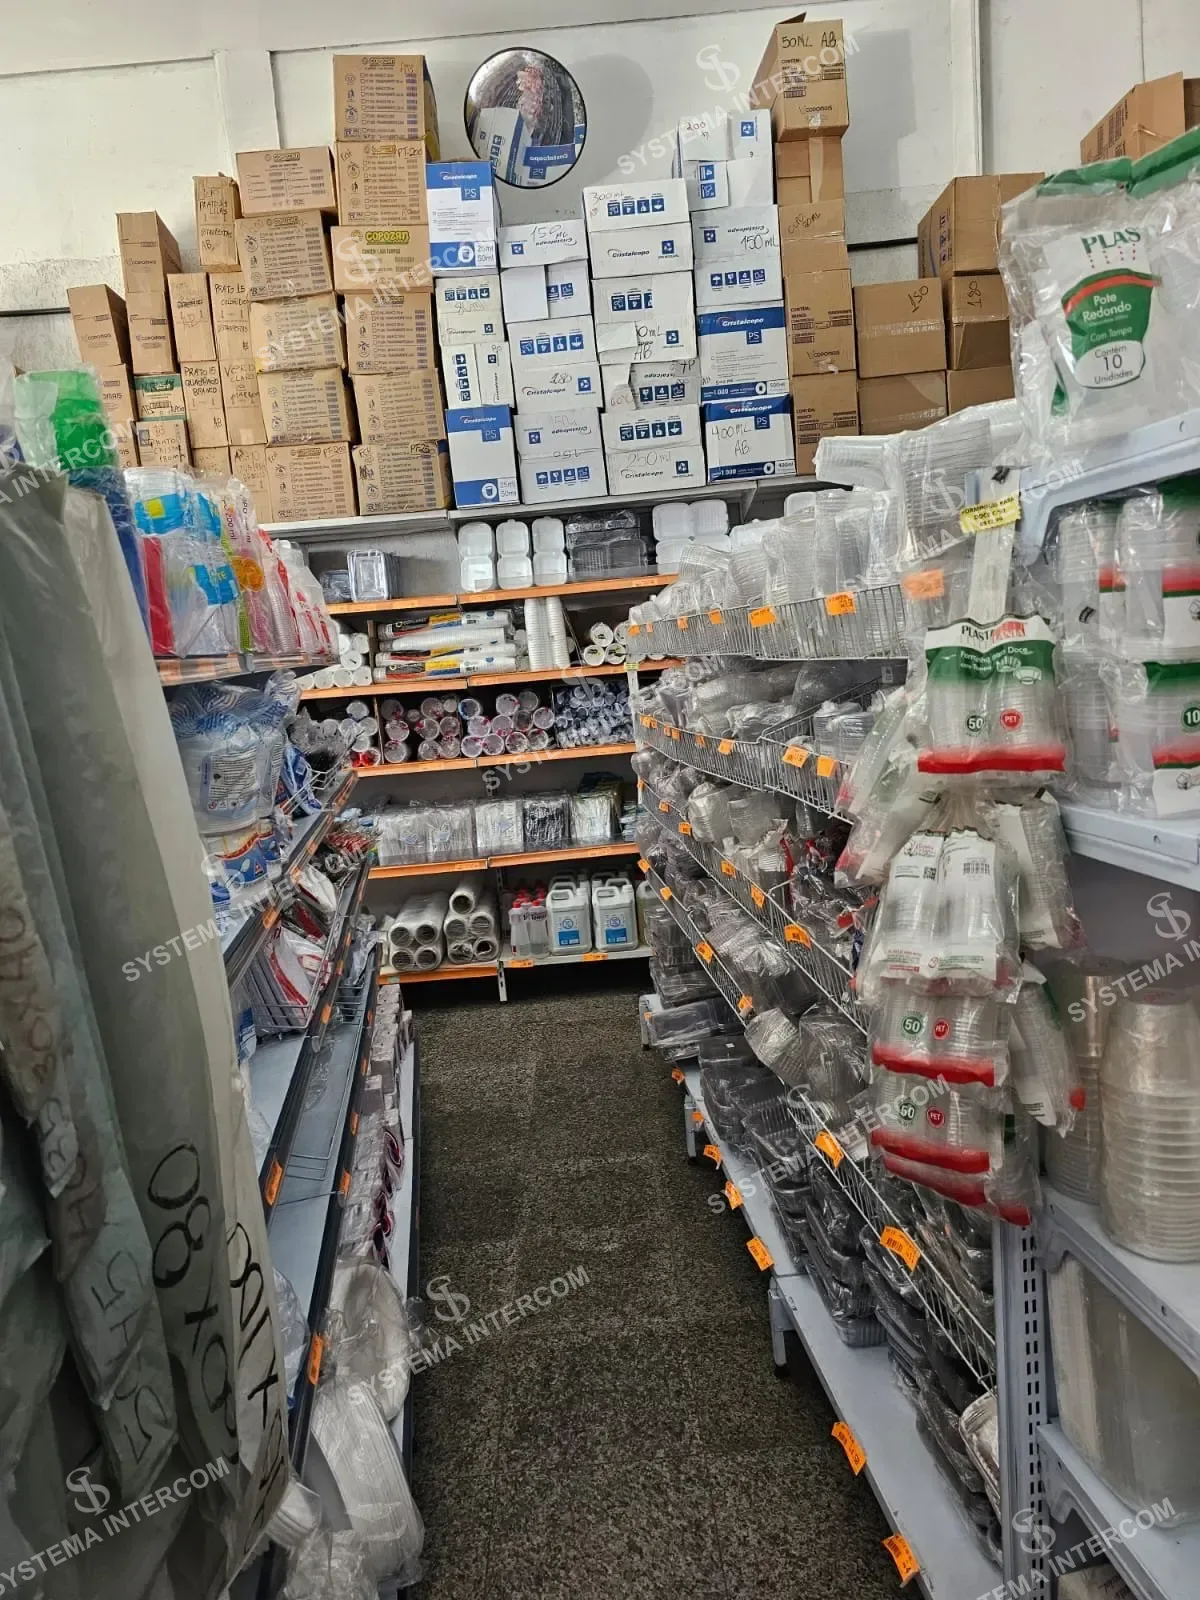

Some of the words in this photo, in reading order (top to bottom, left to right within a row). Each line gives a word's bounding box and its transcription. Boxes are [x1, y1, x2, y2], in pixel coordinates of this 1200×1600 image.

[464, 188, 477, 198] PS
[1093, 293, 1117, 307] Pote
[1082, 303, 1132, 322] Redondo
[720, 317, 764, 328] Cristalcopo
[748, 332, 760, 340] PS
[1108, 326, 1133, 340] Tampa
[1103, 354, 1123, 371] 10
[1094, 370, 1133, 385] Unidades
[756, 417, 768, 425] PS
[484, 429, 497, 440] PS
[967, 717, 984, 729] 50
[1004, 715, 1017, 723] PET
[904, 1019, 920, 1033] 50
[935, 1024, 947, 1033] PET
[930, 1112, 942, 1121] PET
